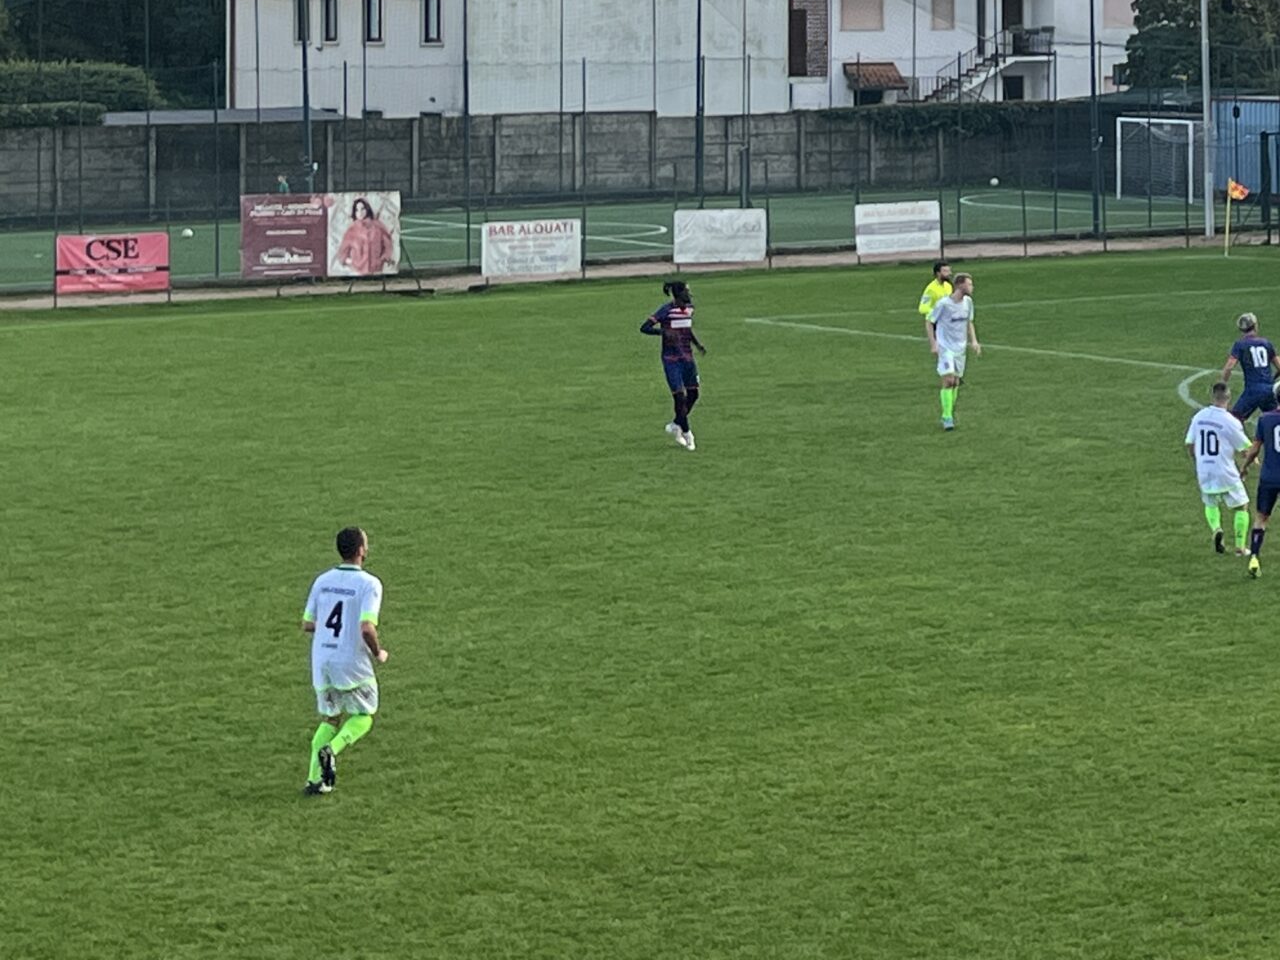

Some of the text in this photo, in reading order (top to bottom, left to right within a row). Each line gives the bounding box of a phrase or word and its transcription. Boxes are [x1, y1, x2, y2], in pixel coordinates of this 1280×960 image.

[489, 224, 515, 236] BAR
[1249, 345, 1268, 367] 10
[1200, 429, 1220, 456] 10
[325, 600, 343, 638] 4
